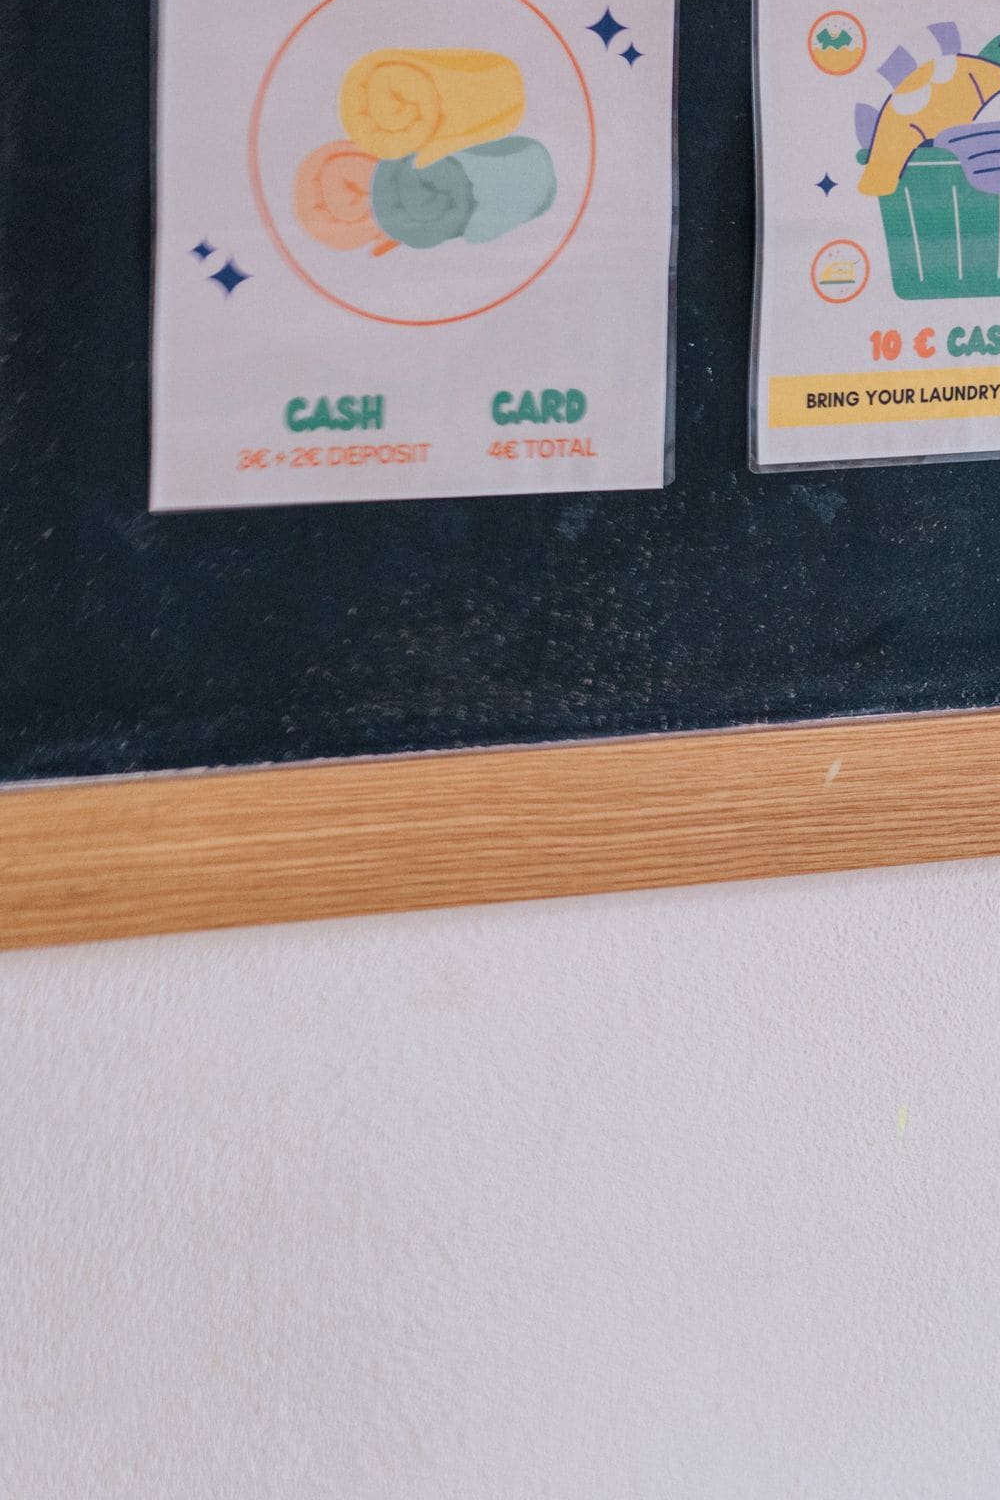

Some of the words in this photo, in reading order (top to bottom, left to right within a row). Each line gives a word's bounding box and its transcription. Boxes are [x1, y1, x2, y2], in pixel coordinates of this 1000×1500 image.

[870, 329, 902, 361] 10
[913, 327, 936, 359] €
[806, 391, 860, 409] BRING
[866, 388, 915, 406] YOUR
[920, 384, 1000, 404] LAUNDRY
[285, 395, 384, 432] CASH
[491, 388, 587, 425] CARD
[291, 447, 321, 468] 2€
[328, 442, 431, 467] DEPOSIT
[487, 440, 518, 461] 4€
[525, 437, 598, 460] TOTAL
